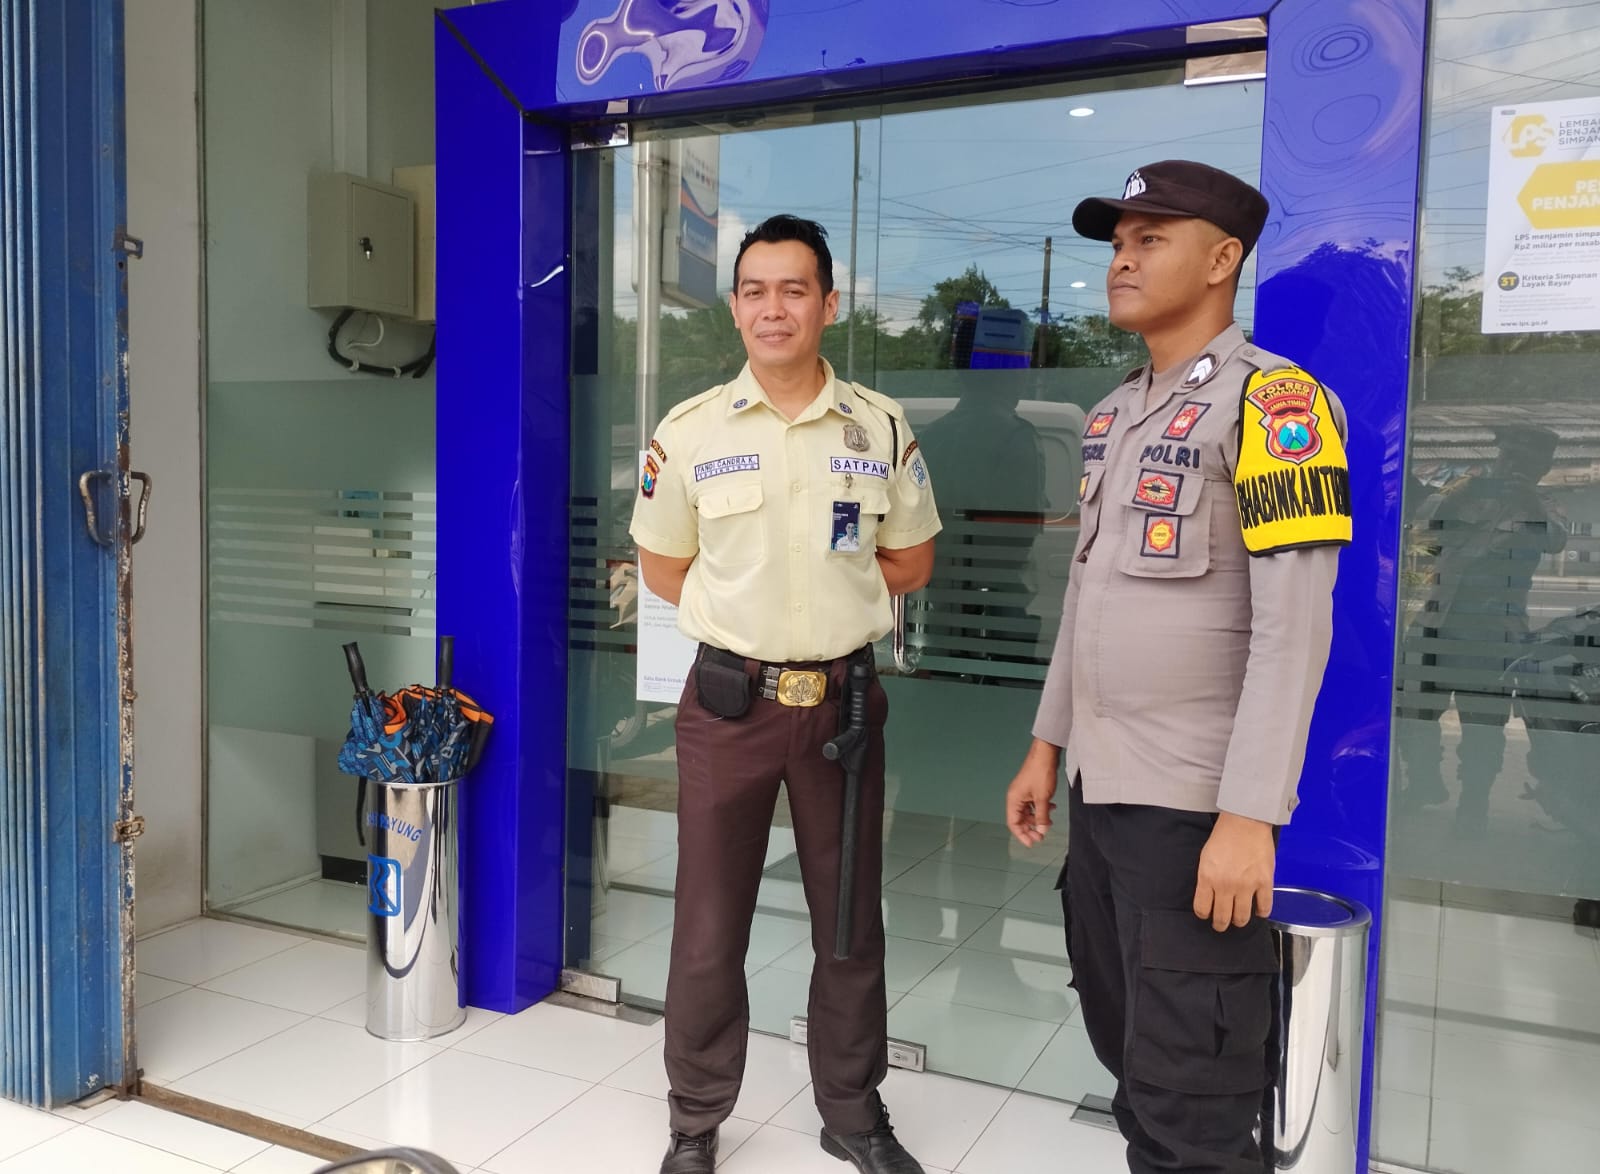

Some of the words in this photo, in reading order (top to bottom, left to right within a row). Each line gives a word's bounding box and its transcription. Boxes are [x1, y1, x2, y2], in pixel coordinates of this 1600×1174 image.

[1575, 178, 1600, 194] PE
[1257, 382, 1310, 399] POLRES
[1139, 444, 1200, 469] POLRI
[833, 459, 887, 477] SATPAM
